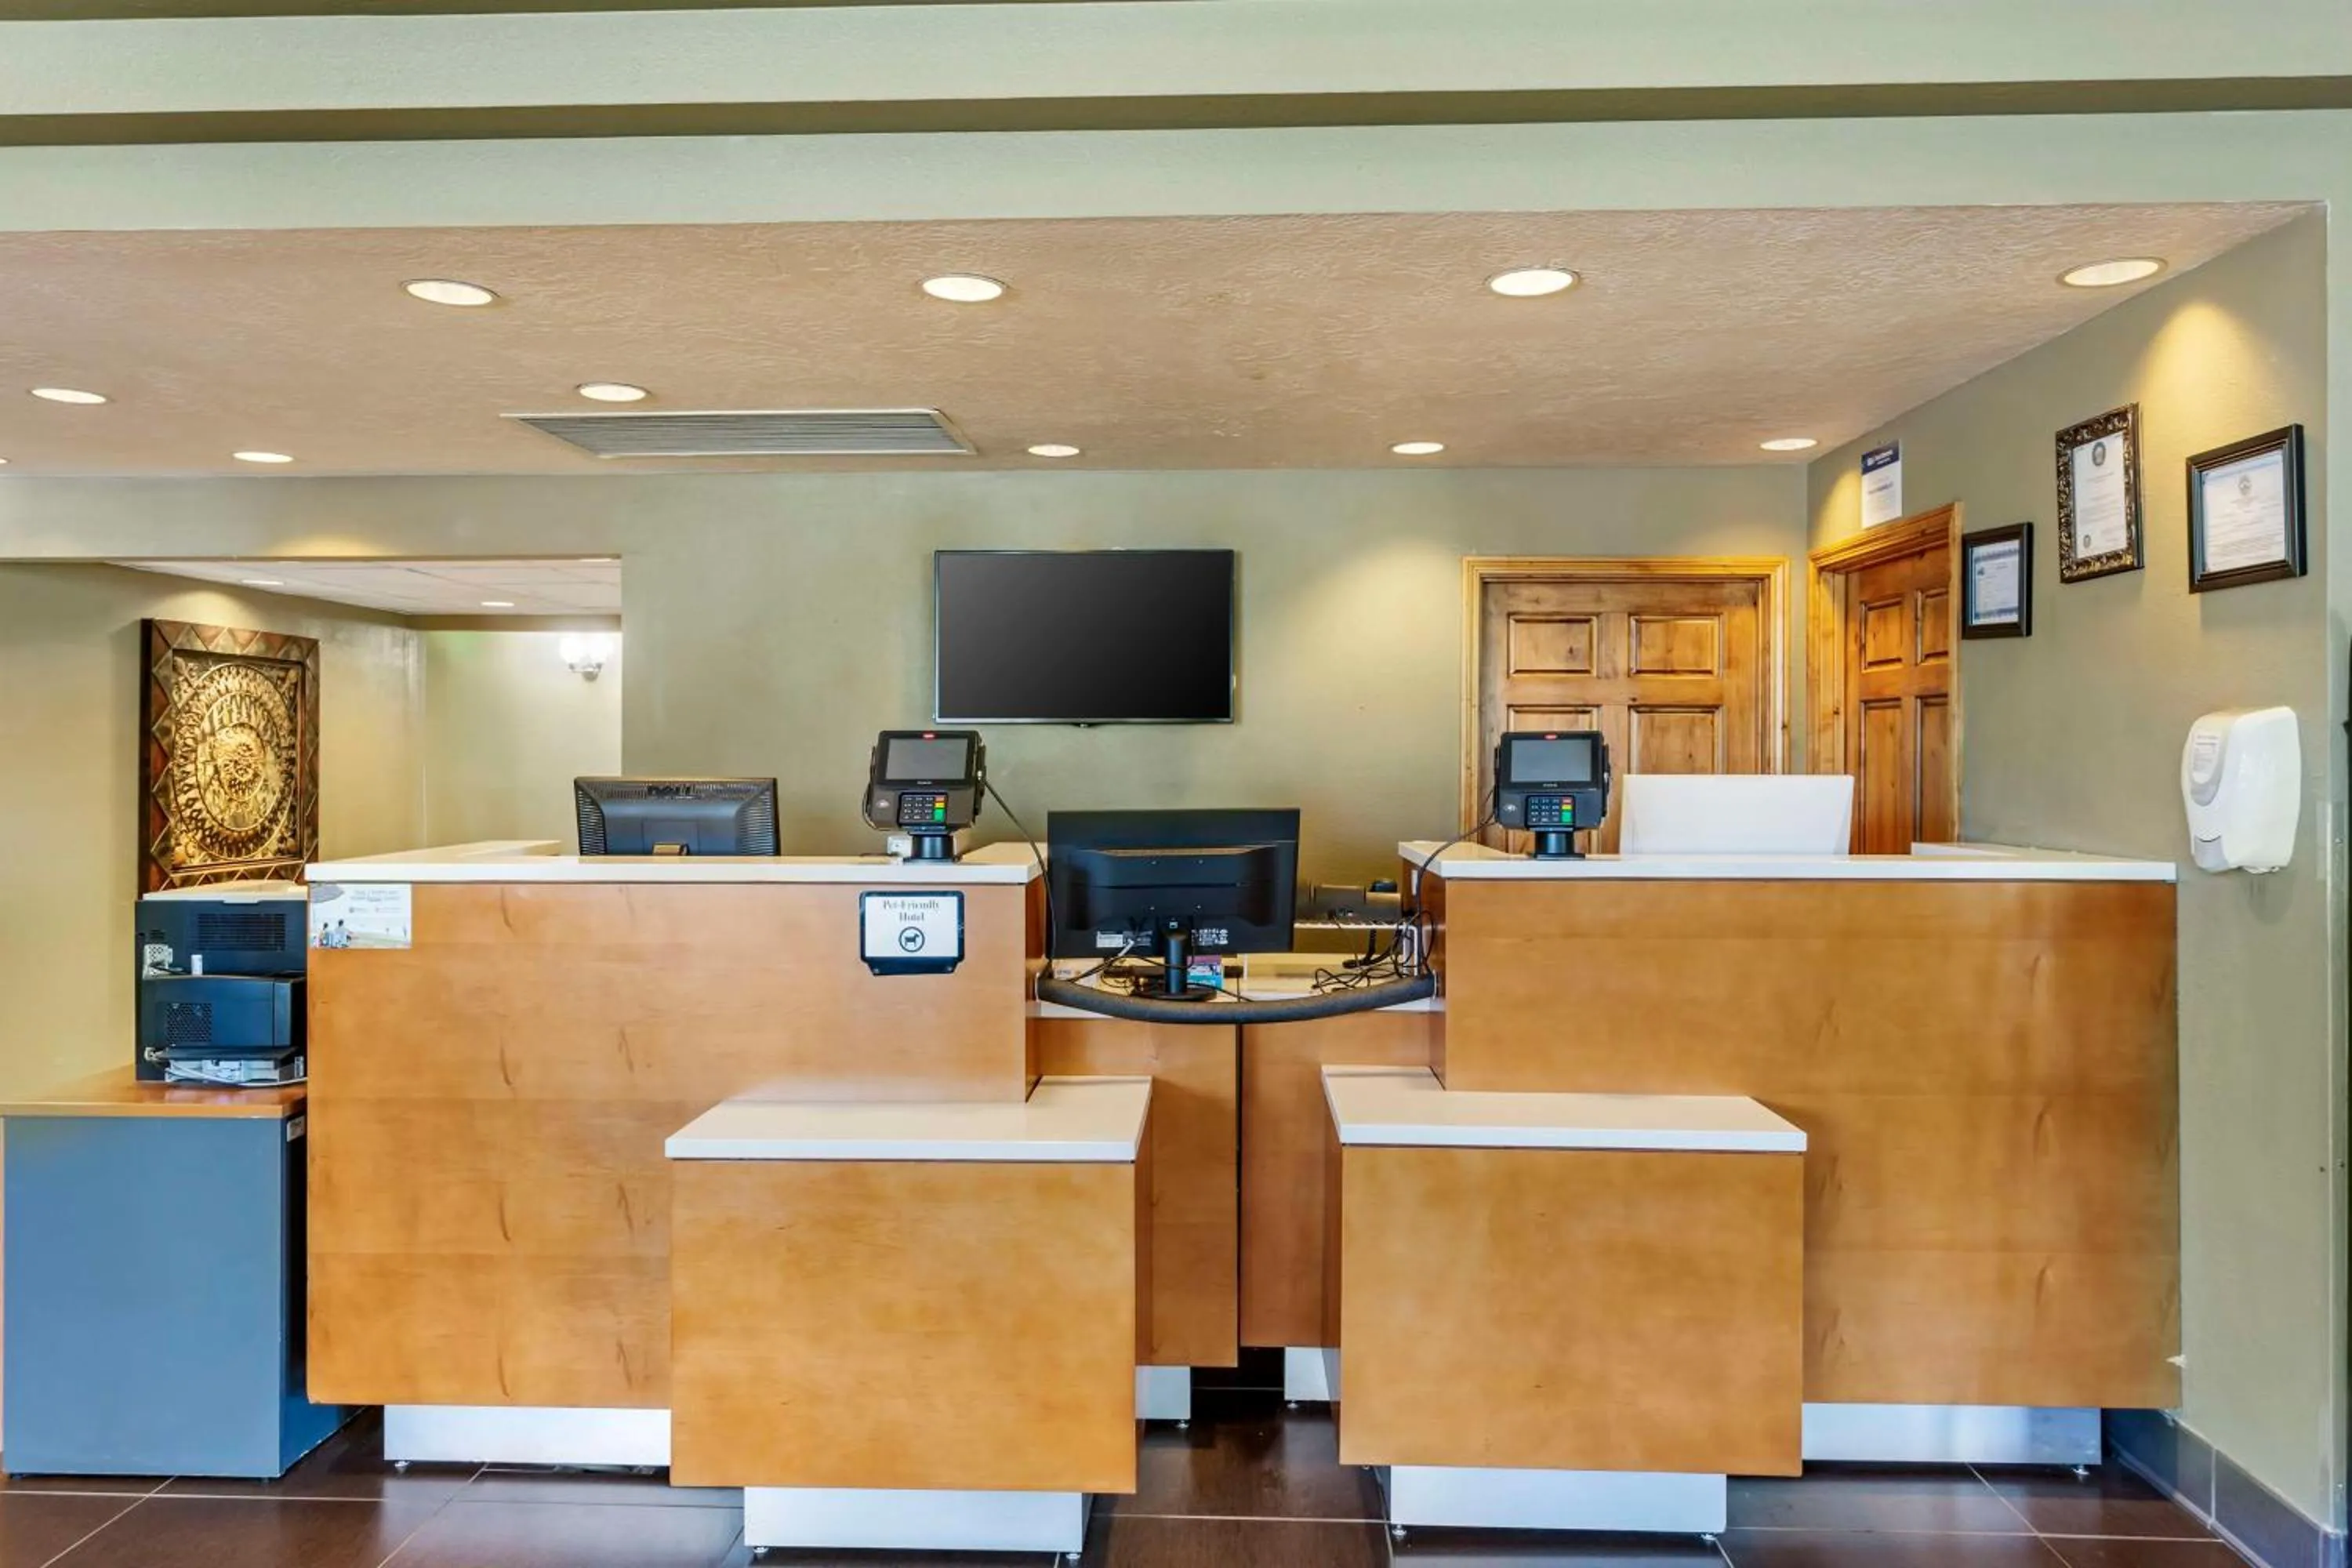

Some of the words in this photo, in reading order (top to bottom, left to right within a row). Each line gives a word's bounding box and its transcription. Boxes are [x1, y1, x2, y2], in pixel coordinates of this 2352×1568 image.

[648, 785, 700, 800] DELL
[883, 899, 939, 911] Pet-Friendly
[898, 912, 925, 922] Hotel
